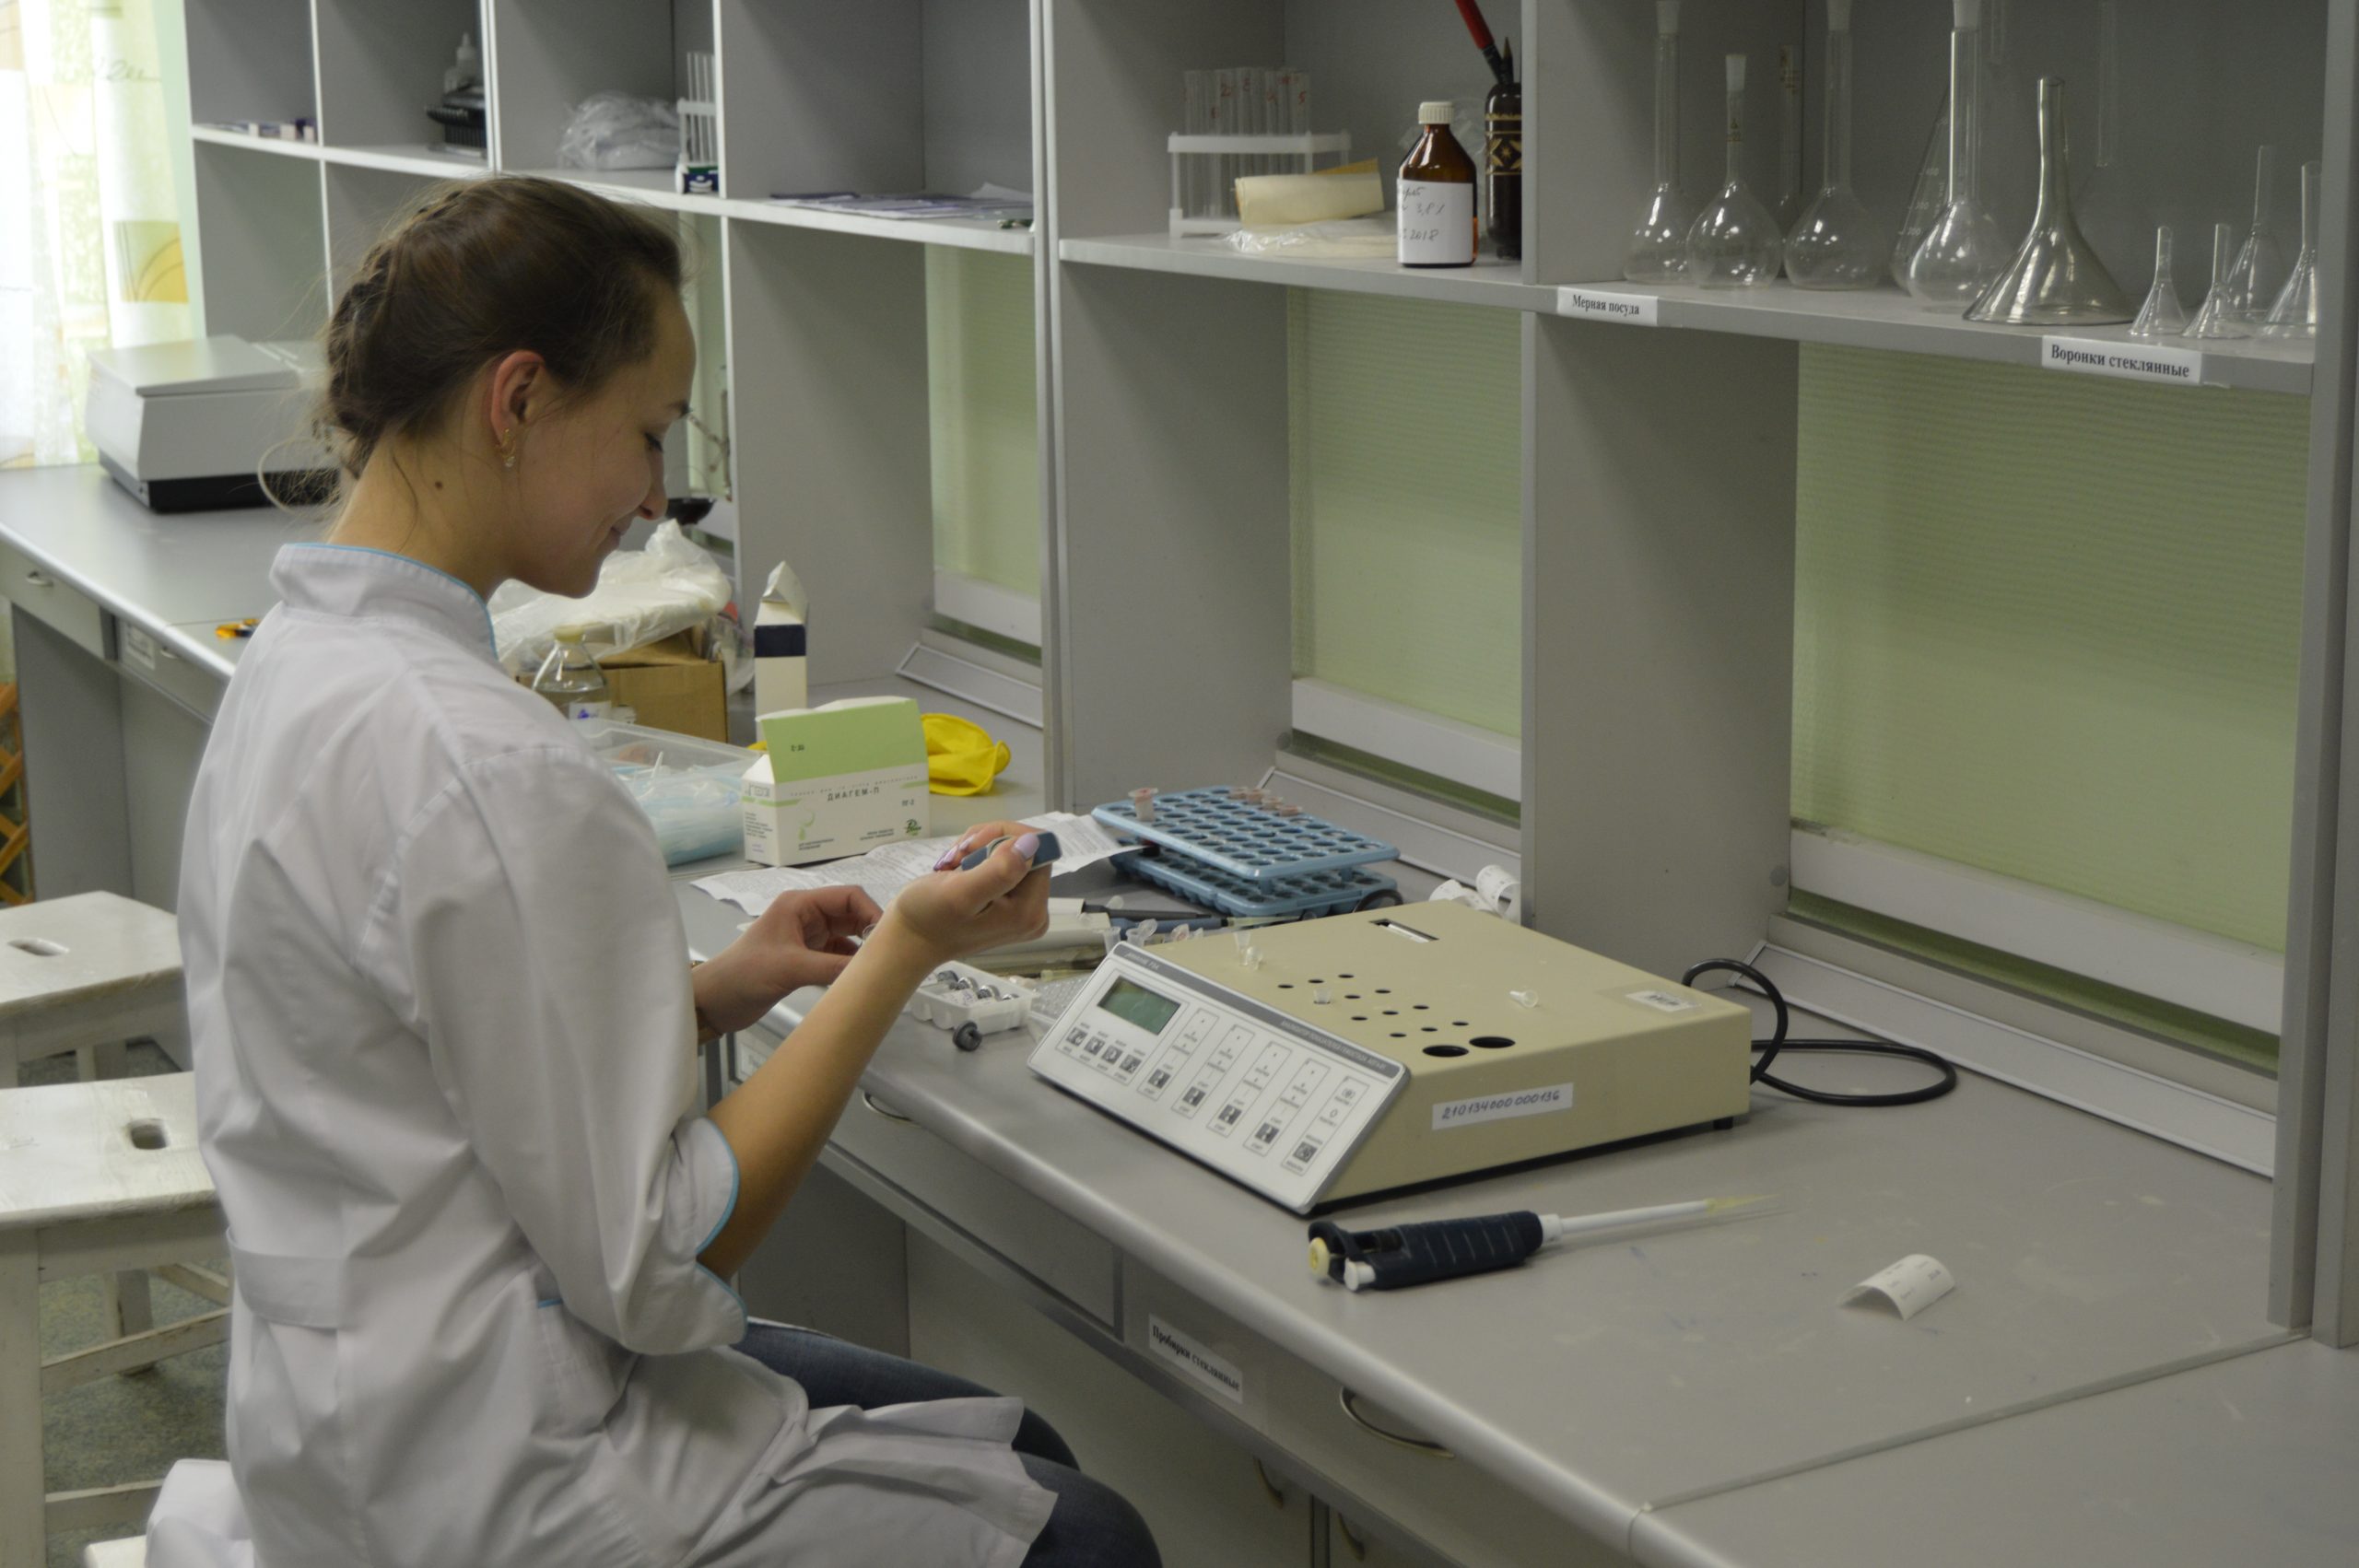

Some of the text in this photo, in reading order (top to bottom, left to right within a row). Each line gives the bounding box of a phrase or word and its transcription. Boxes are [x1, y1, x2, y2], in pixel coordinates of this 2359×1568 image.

[1572, 294, 1639, 317] Мерная посуда
[2050, 344, 2190, 379] Воронки стеклянные
[1153, 1325, 1239, 1392] Пробирки стеклянные
